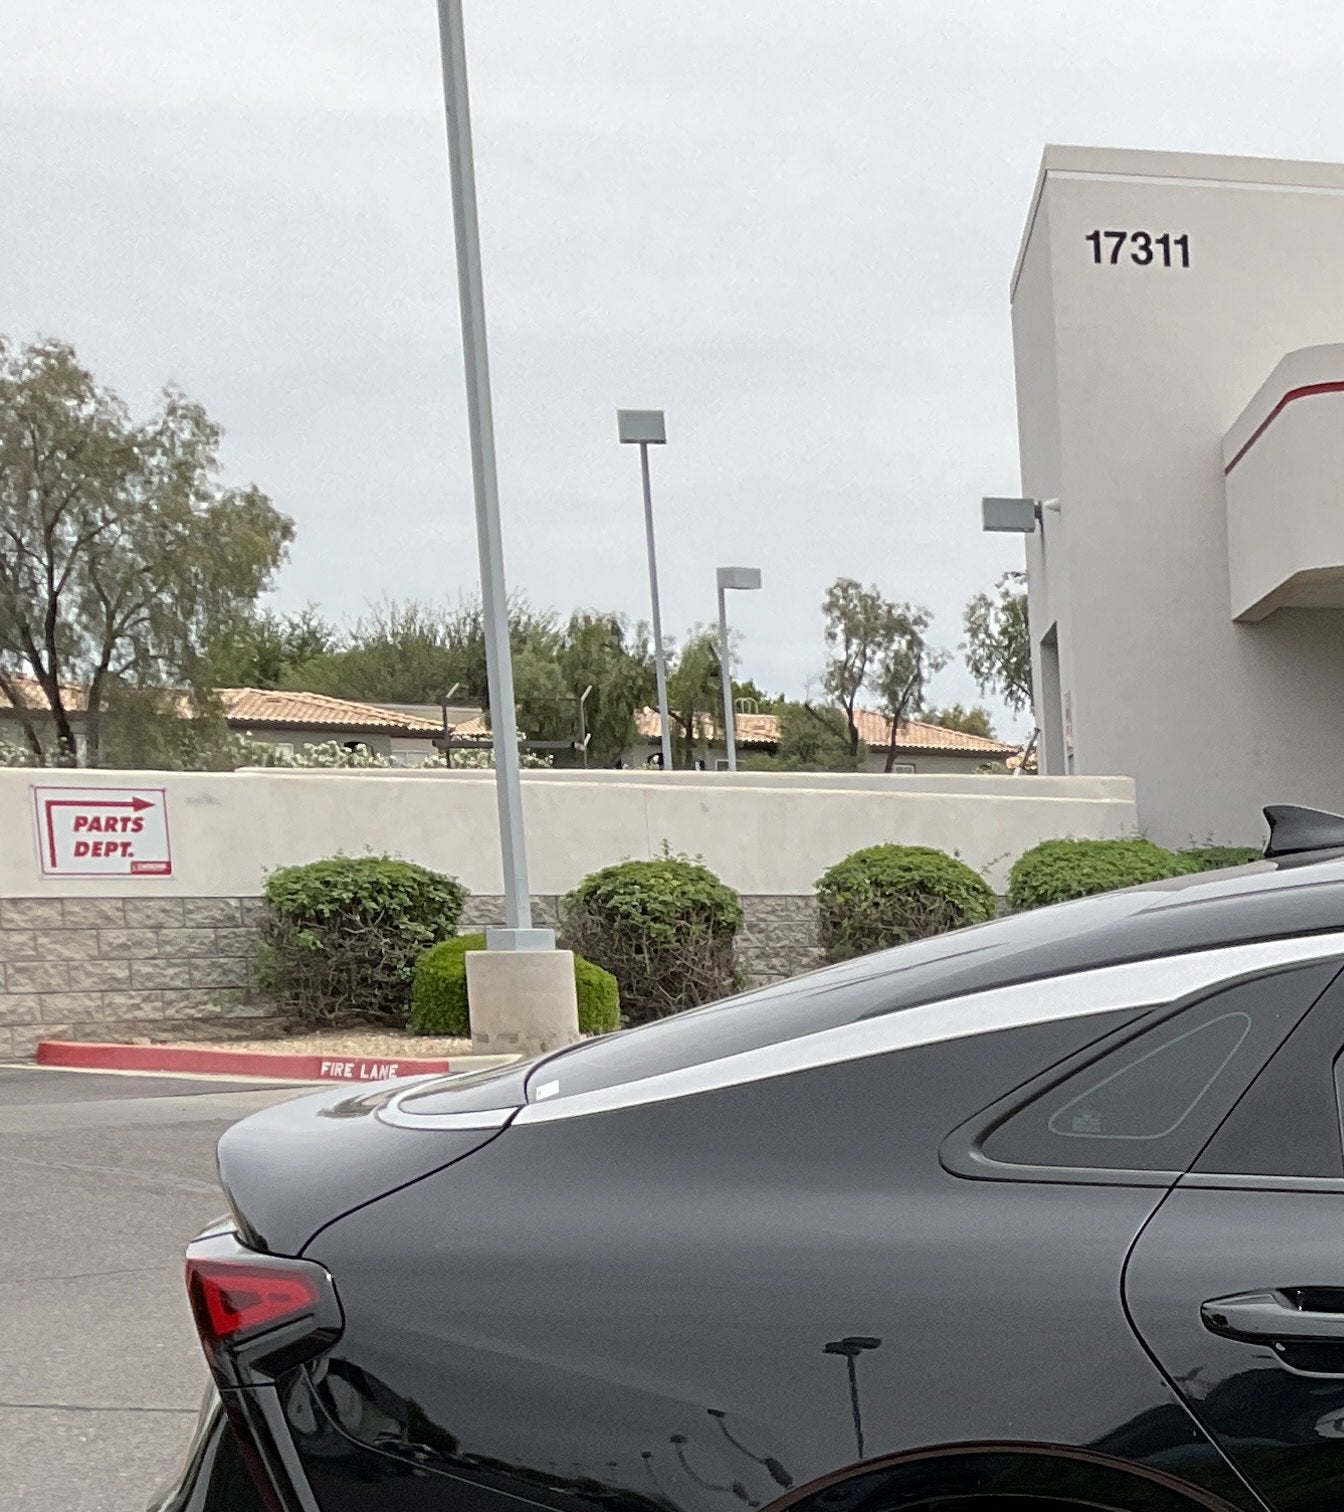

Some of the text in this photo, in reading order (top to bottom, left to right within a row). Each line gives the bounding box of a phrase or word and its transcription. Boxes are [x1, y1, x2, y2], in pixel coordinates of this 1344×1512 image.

[1085, 229, 1190, 268] 17311
[73, 816, 144, 832] PARTS
[73, 841, 134, 858] DEPT.
[320, 1061, 399, 1080] FIRE LANE
